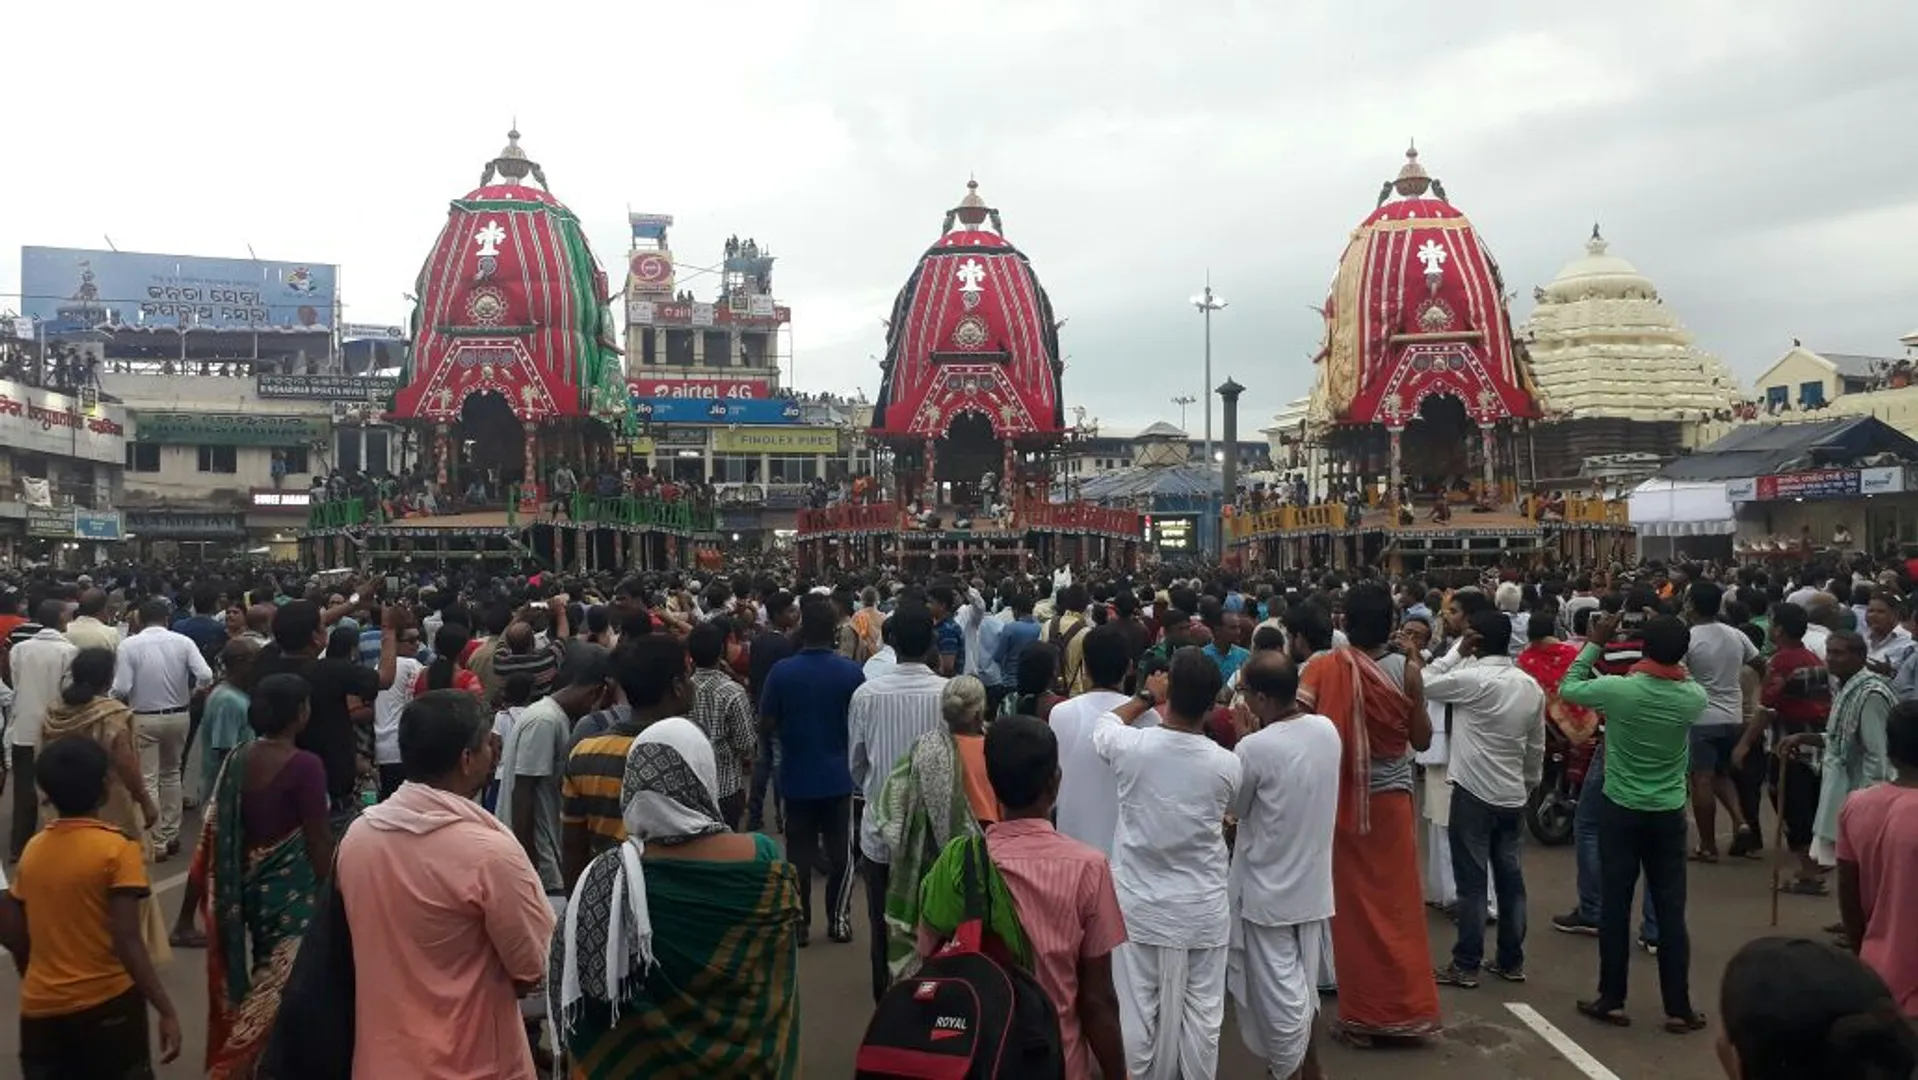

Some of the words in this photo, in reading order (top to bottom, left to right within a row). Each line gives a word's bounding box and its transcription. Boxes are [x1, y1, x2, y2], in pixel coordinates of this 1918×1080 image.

[673, 382, 719, 399] airtel
[727, 384, 752, 399] 4G
[709, 404, 726, 415] Jio
[782, 405, 799, 417] Jio
[741, 435, 793, 446] FINOLEX
[797, 435, 831, 446] PIPES
[935, 1016, 967, 1029] ROYAL
